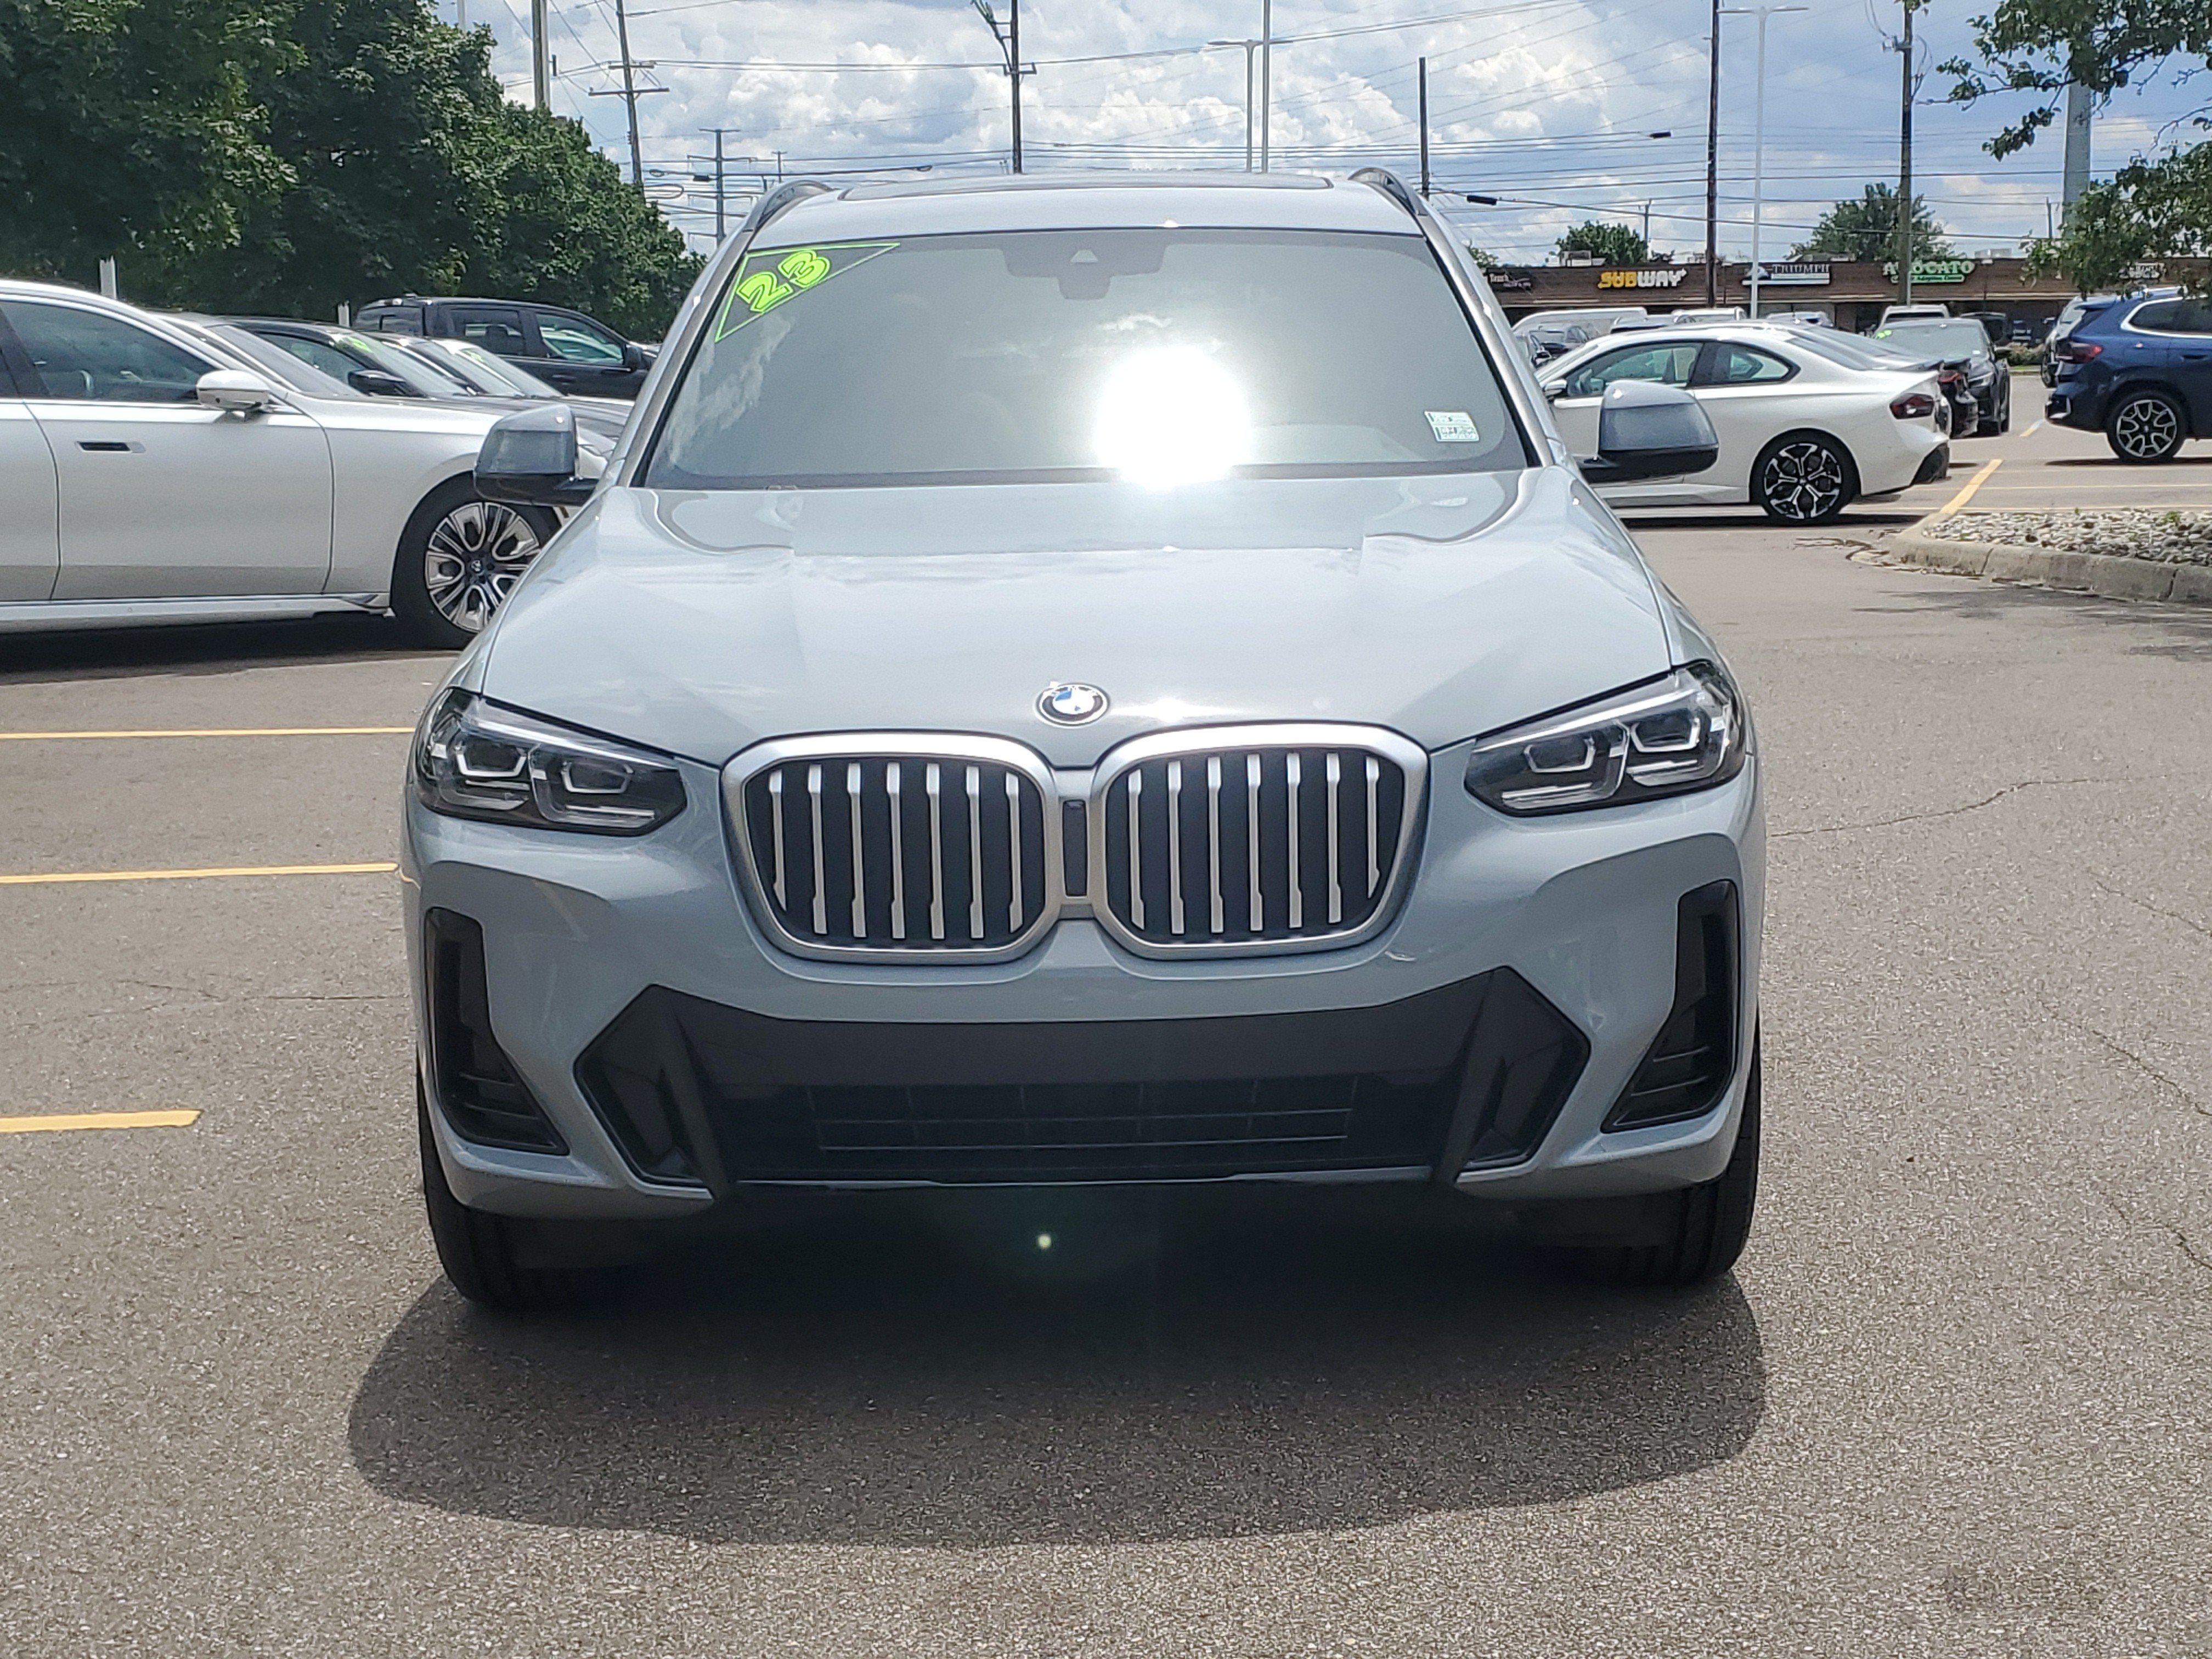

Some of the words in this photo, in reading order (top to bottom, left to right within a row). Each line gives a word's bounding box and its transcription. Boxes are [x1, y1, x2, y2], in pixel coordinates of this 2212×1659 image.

[1598, 268, 1687, 289] SUBWAY
[1772, 264, 1830, 274] TRIUMPH
[736, 249, 831, 313] 23
